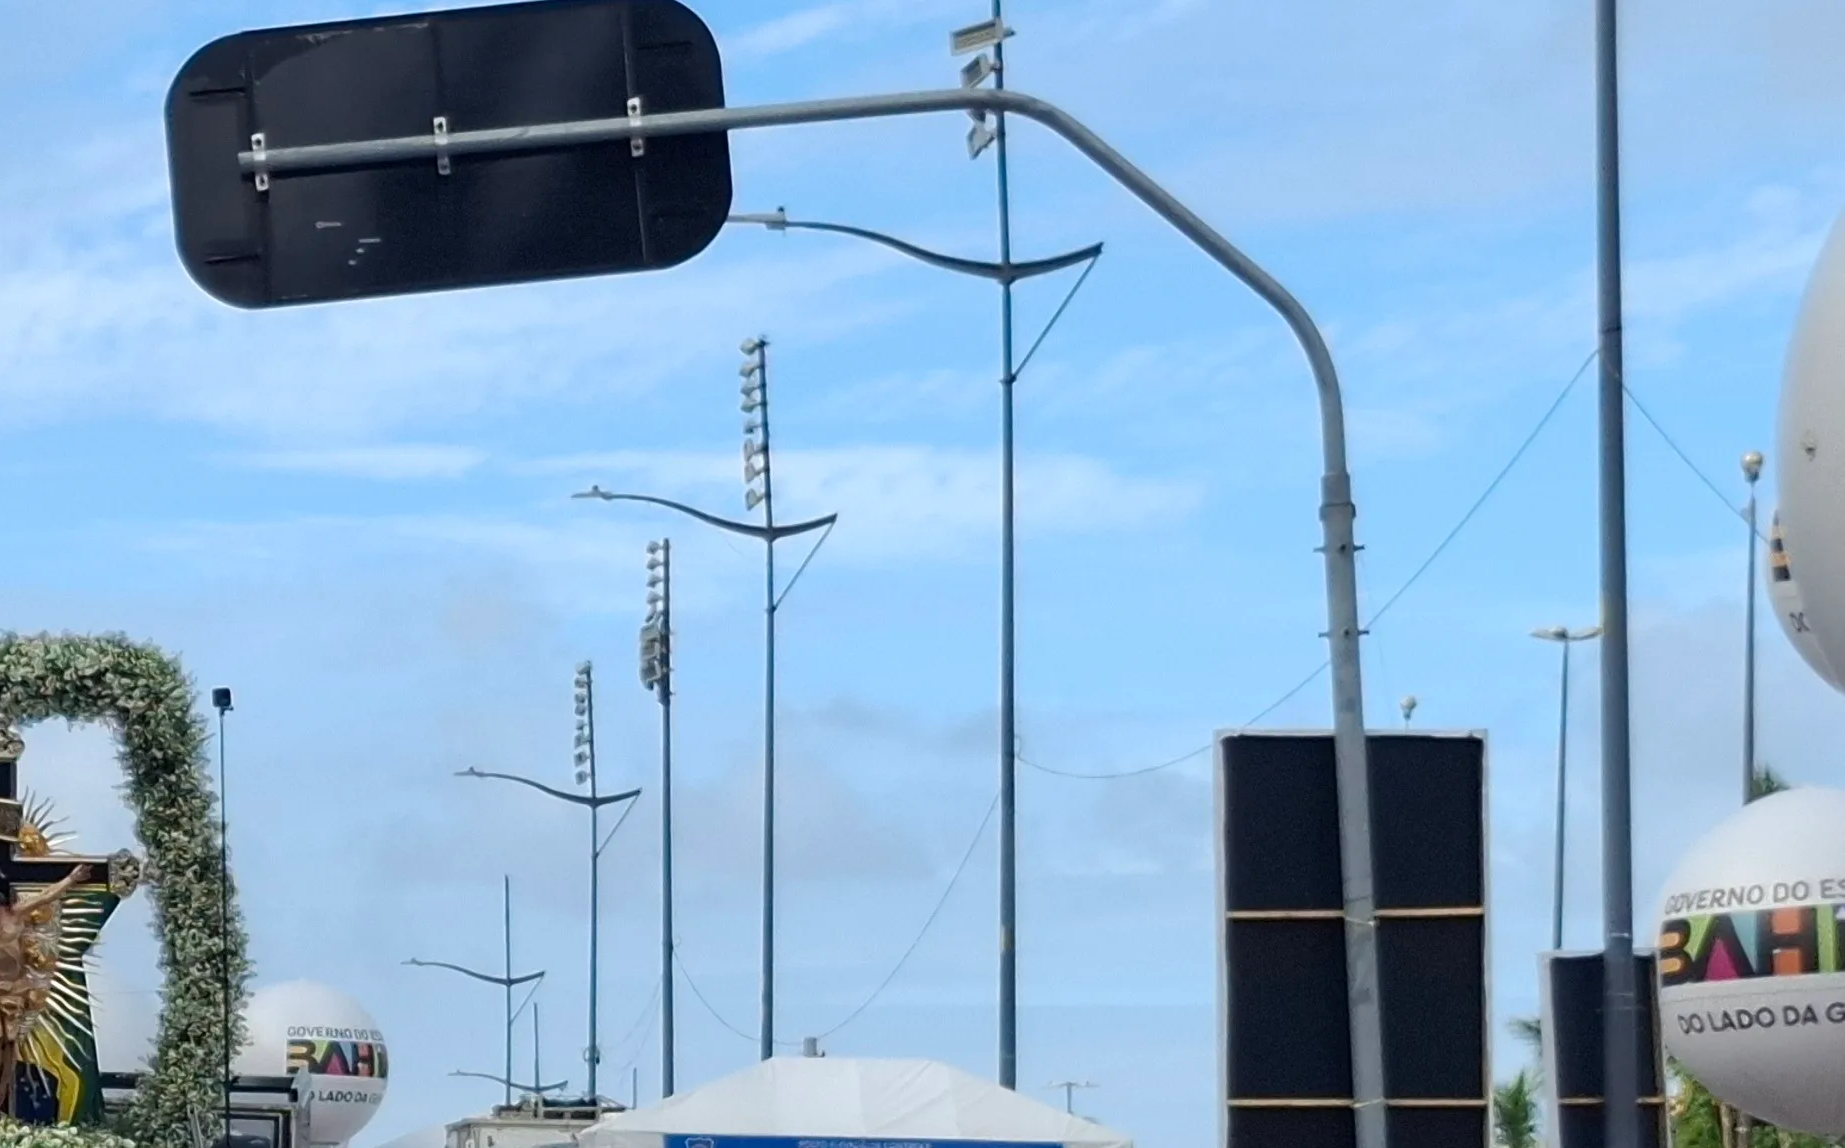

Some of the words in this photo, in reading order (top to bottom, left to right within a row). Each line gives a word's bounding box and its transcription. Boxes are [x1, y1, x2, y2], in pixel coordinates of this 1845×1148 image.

[1665, 884, 1765, 915] GOVERNO
[1772, 880, 1810, 903] DO
[1677, 1012, 1705, 1035] DO
[1707, 1006, 1776, 1033] LADO
[1782, 1004, 1819, 1026] DA
[286, 1026, 353, 1039] GOVERNO
[318, 1090, 354, 1102] LADO
